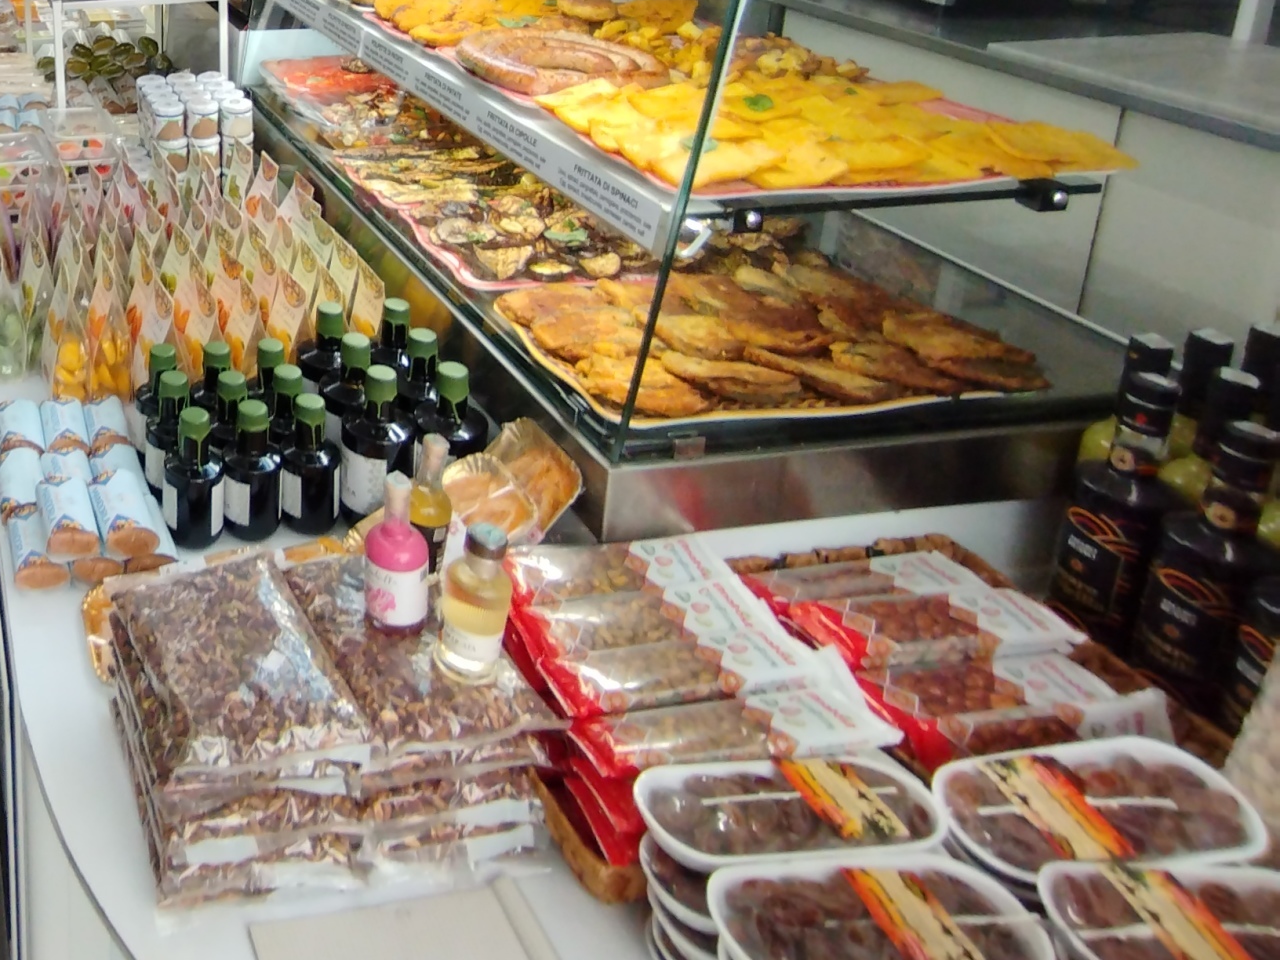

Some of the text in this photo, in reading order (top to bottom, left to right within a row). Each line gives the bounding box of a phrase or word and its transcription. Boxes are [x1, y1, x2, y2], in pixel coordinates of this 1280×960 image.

[487, 110, 508, 129] FRITTATA
[515, 129, 537, 147] CIPOLLE
[573, 164, 639, 209] FRITTATA DI SPINACI
